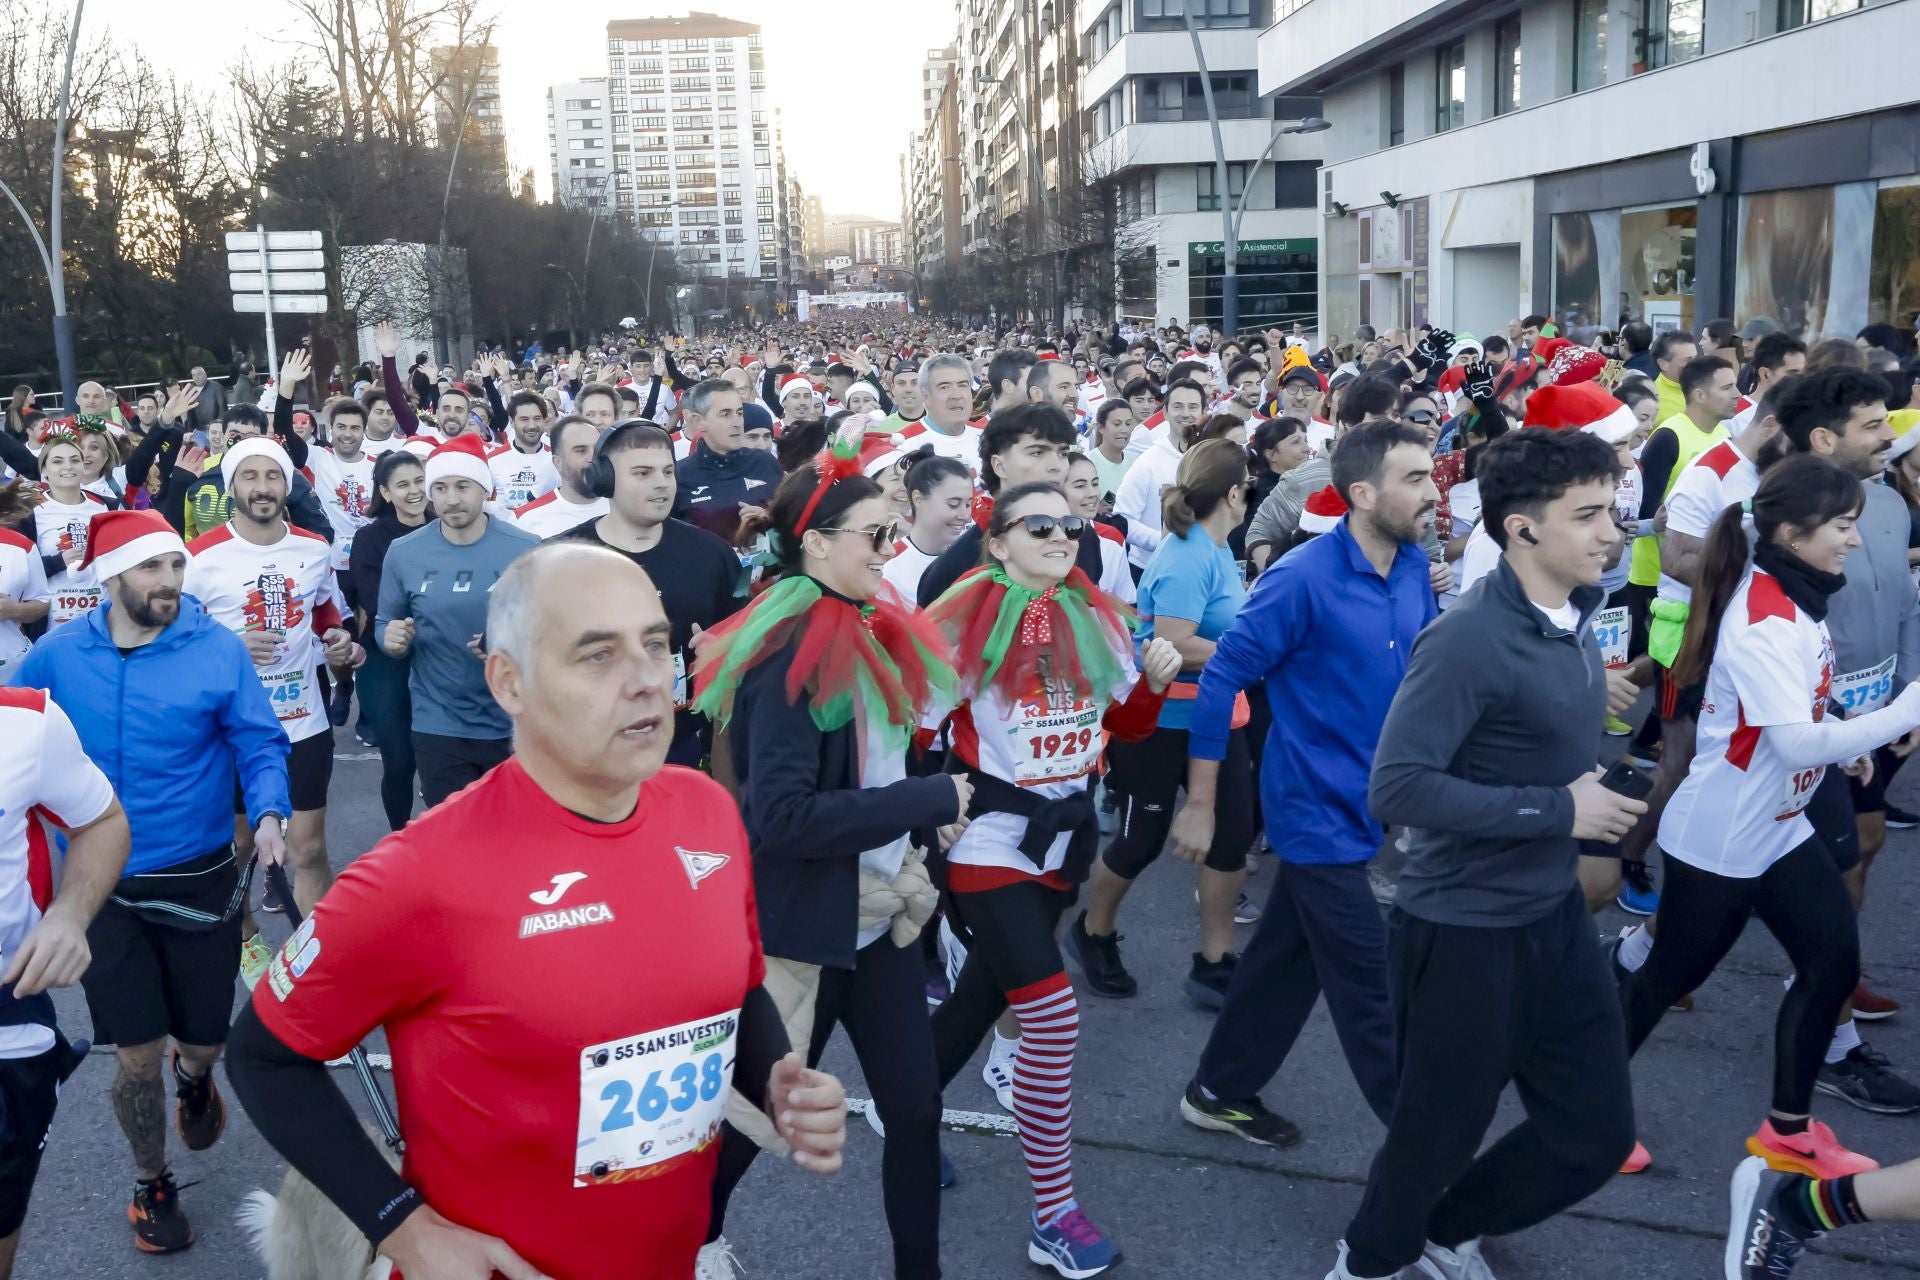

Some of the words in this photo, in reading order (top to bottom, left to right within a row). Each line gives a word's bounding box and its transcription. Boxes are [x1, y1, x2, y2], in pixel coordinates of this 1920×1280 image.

[1243, 240, 1287, 252] Asistencial
[71, 534, 87, 542] SIL
[269, 574, 285, 585] 55
[262, 581, 286, 593] SAN
[58, 595, 98, 609] 1902
[264, 592, 286, 605] SIL
[265, 604, 287, 617] VES
[264, 616, 287, 630] TRE
[274, 669, 304, 680] SILVESTRE
[1856, 671, 1871, 680] SAN
[1044, 678, 1072, 693] SIL
[1840, 673, 1890, 709] 3735
[1046, 692, 1074, 709] VES
[1036, 720, 1047, 728] 55
[1048, 719, 1065, 727] SAN
[1065, 709, 1098, 725] SILVESTRE
[1029, 728, 1092, 759] 1929
[614, 1043, 634, 1061] 55
[636, 1035, 666, 1056] SAN
[668, 1017, 732, 1048] SILVESTR
[600, 1052, 723, 1133] 2638
[1744, 1208, 1775, 1266] HOKA
